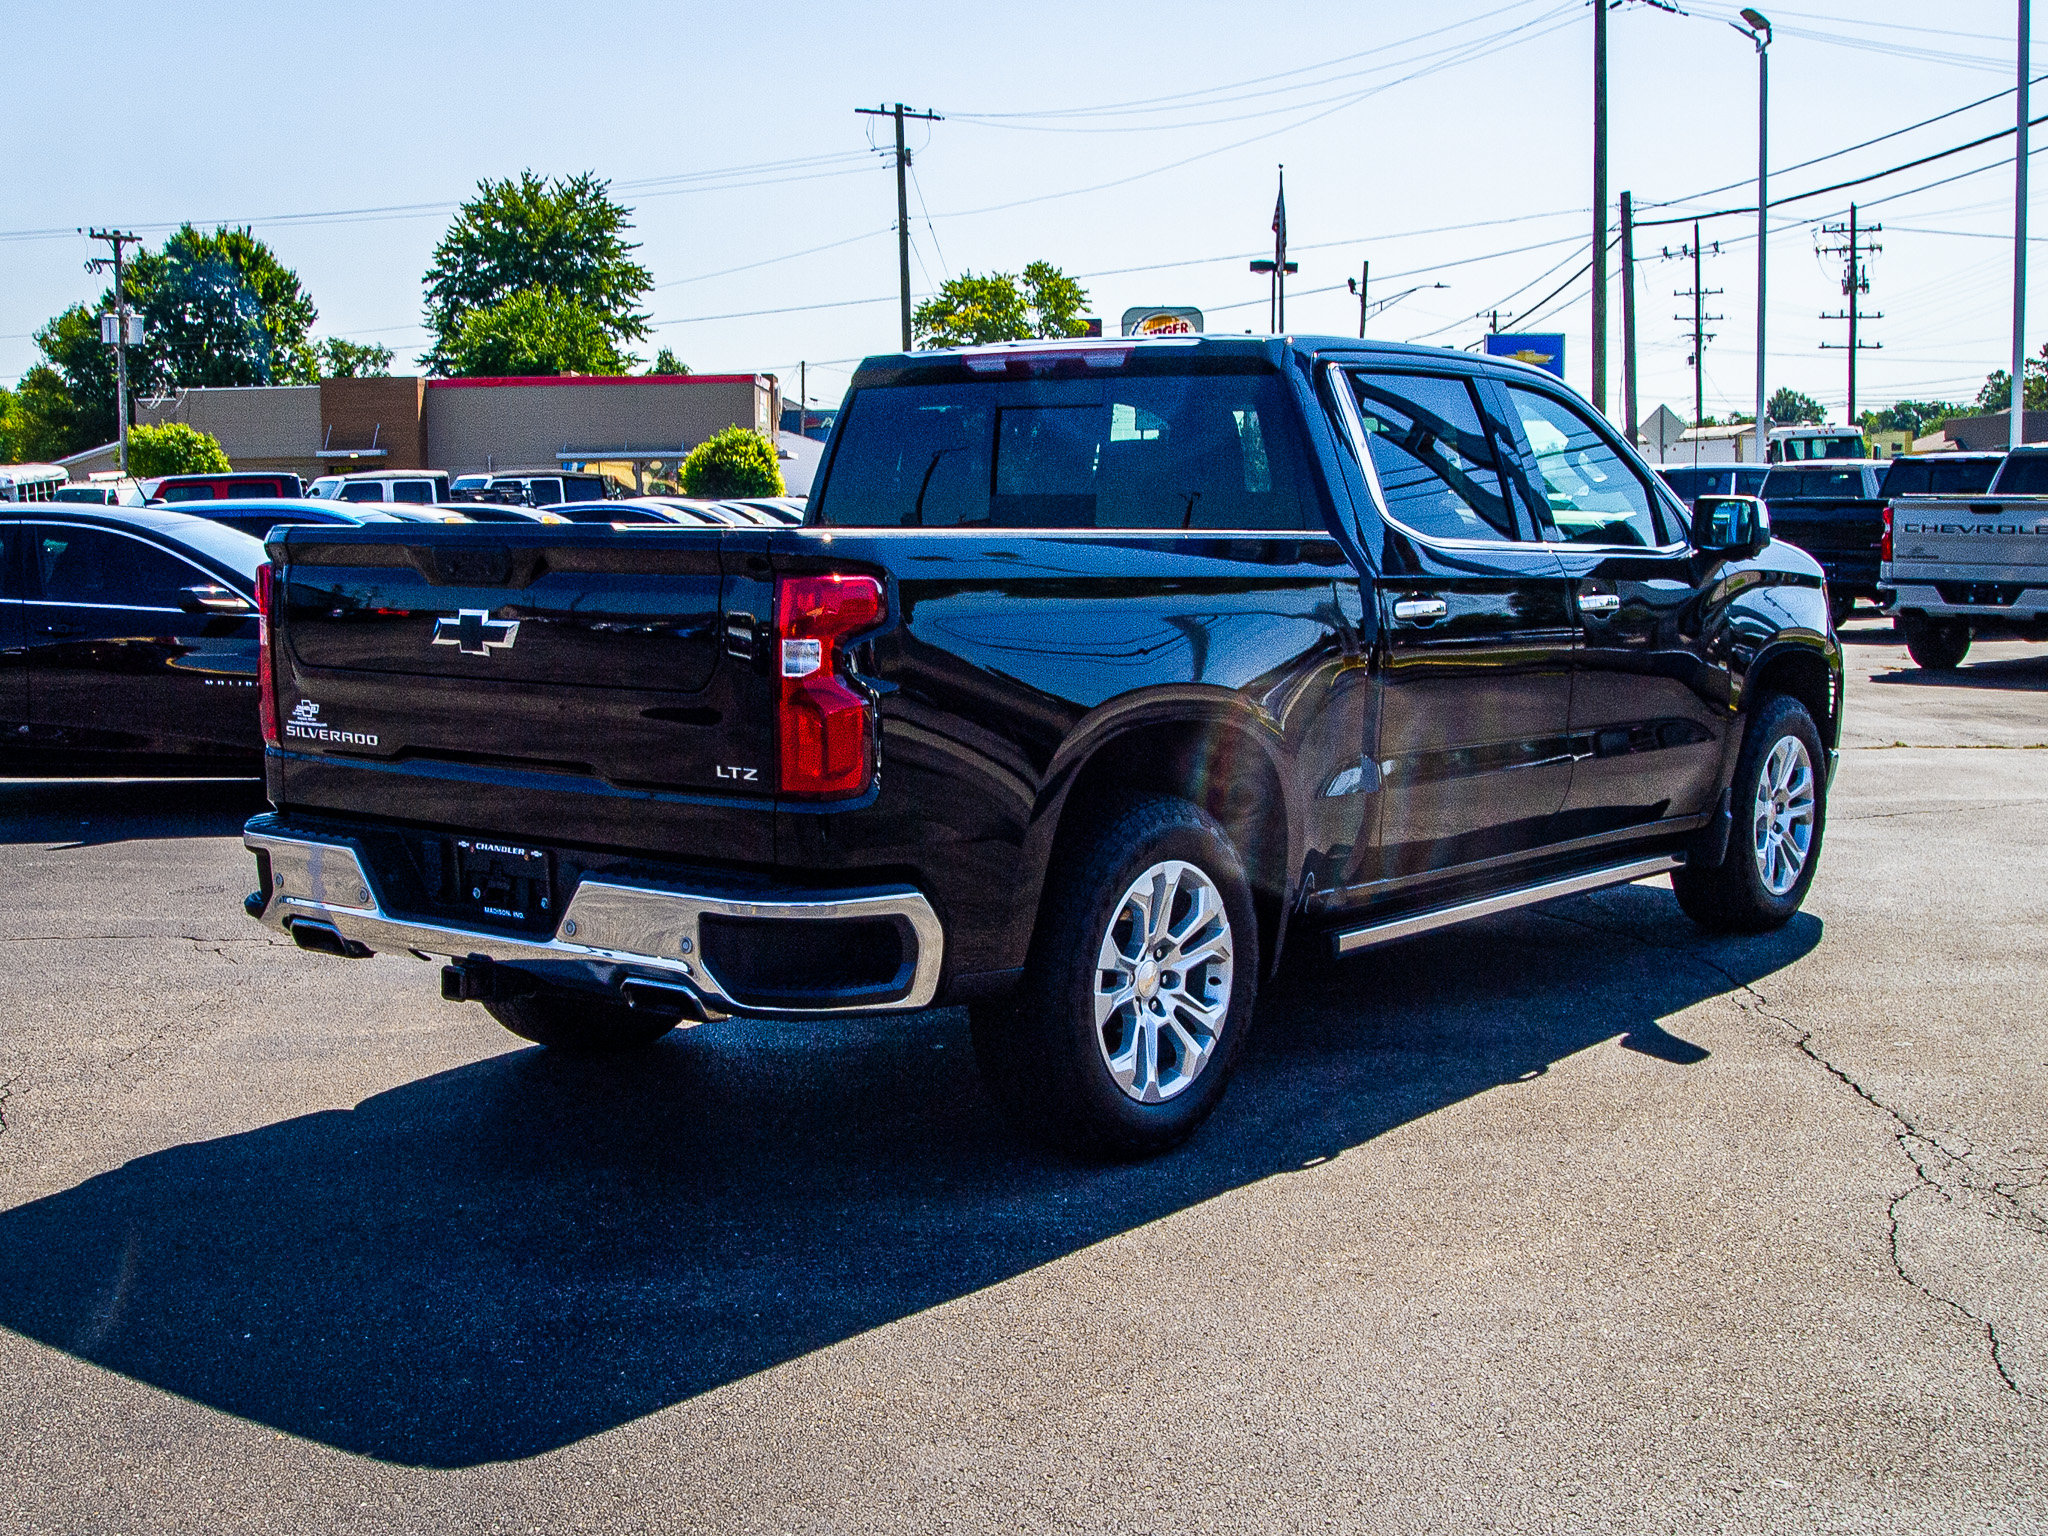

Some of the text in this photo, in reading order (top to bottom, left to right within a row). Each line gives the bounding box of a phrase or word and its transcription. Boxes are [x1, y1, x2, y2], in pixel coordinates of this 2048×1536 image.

[286, 725, 379, 746] SILVERADO
[716, 765, 759, 781] LTZ
[475, 842, 525, 856] CHANDLER
